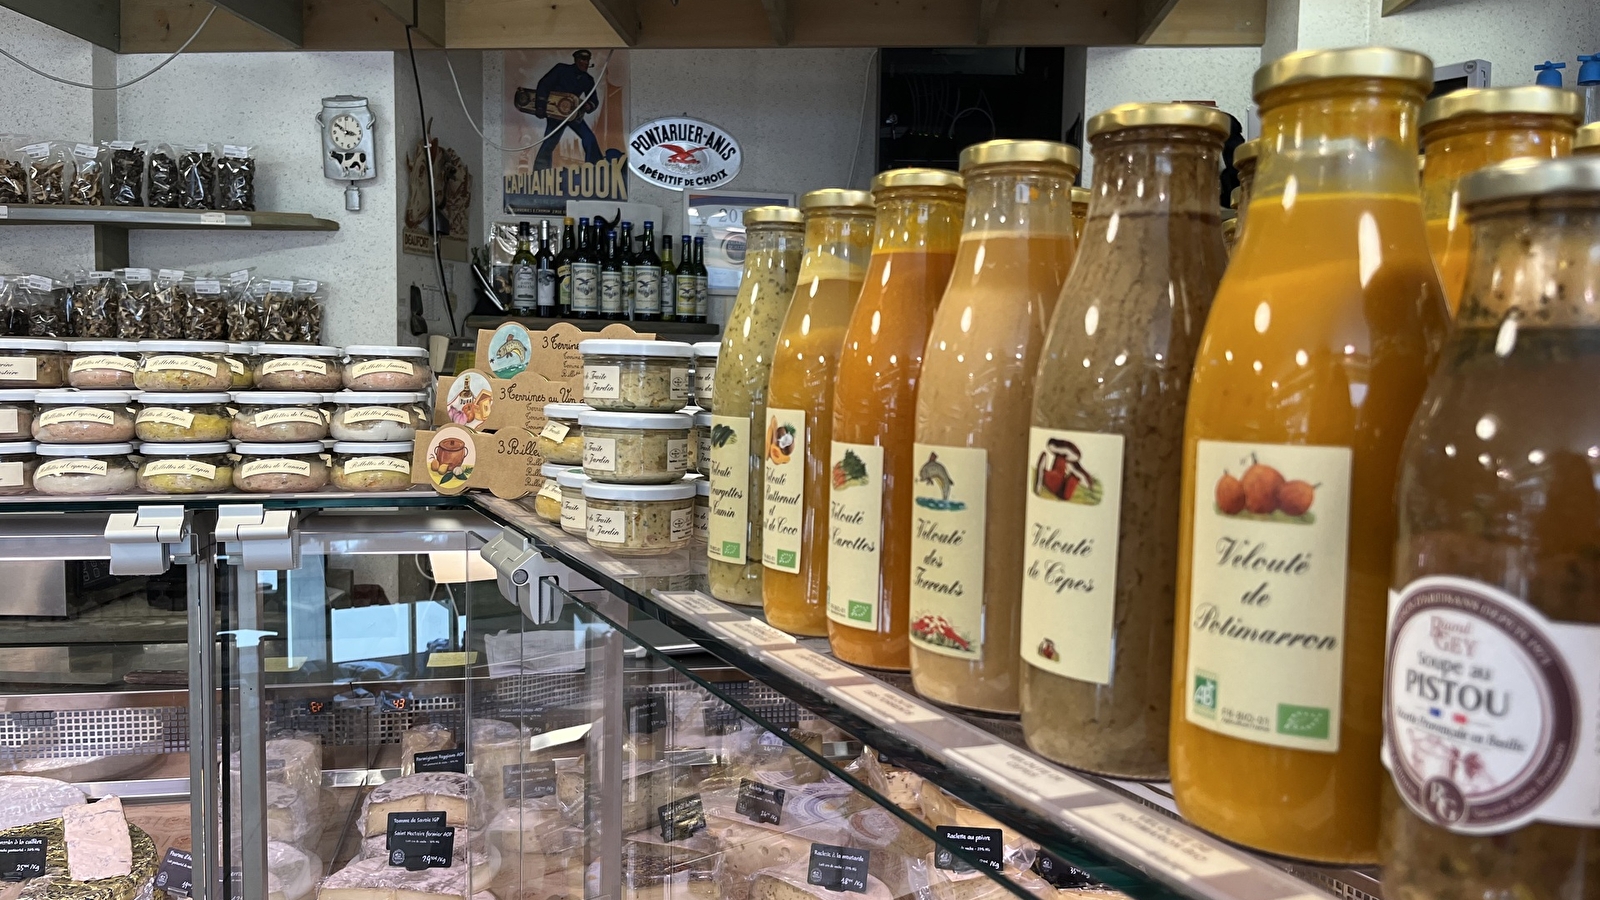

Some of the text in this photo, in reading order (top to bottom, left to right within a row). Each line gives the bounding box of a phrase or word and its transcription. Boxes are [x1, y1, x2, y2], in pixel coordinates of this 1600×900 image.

[630, 123, 737, 162] PONTARLIER-ANIS
[504, 157, 628, 200] CAPITAINE COOK
[637, 164, 729, 187] APÉRITIF DE CHOIX
[542, 333, 580, 350] 3 Terrine
[192, 361, 212, 371] Lapin
[358, 364, 385, 372] Rillettes
[590, 370, 607, 380] Truite
[499, 383, 576, 403] 3 Terrines au Vin
[591, 382, 614, 394] Jardin
[164, 412, 186, 422] Lapin
[261, 412, 290, 422] Rillettes
[351, 410, 380, 419] Rillettes
[498, 438, 540, 457] 3 Rille
[588, 442, 603, 452] Truite
[388, 461, 406, 471] Lapin
[589, 453, 610, 465] Jardin
[149, 463, 176, 473] Rillettes
[187, 463, 210, 474] Lapin
[246, 464, 273, 473] Rillettes
[713, 500, 736, 518] Cumin
[831, 501, 865, 525] Velouté
[594, 513, 612, 524] Truite
[777, 517, 798, 535] Coco
[595, 524, 618, 536] Jardin
[917, 518, 966, 547] Velouté
[832, 528, 875, 553] Carottes
[1032, 522, 1094, 557] Velouté
[923, 549, 943, 568] des
[1216, 536, 1312, 576] Velouté
[1028, 559, 1039, 580] de
[914, 566, 965, 597] Torrents
[1240, 581, 1271, 606] de
[1193, 601, 1338, 651] Potimarron
[1431, 633, 1478, 658] GEY
[1417, 650, 1492, 681] Soupe au
[1404, 668, 1511, 719] PISTOU
[990, 861, 1000, 869] /Kg
[854, 880, 863, 889] /Kg
